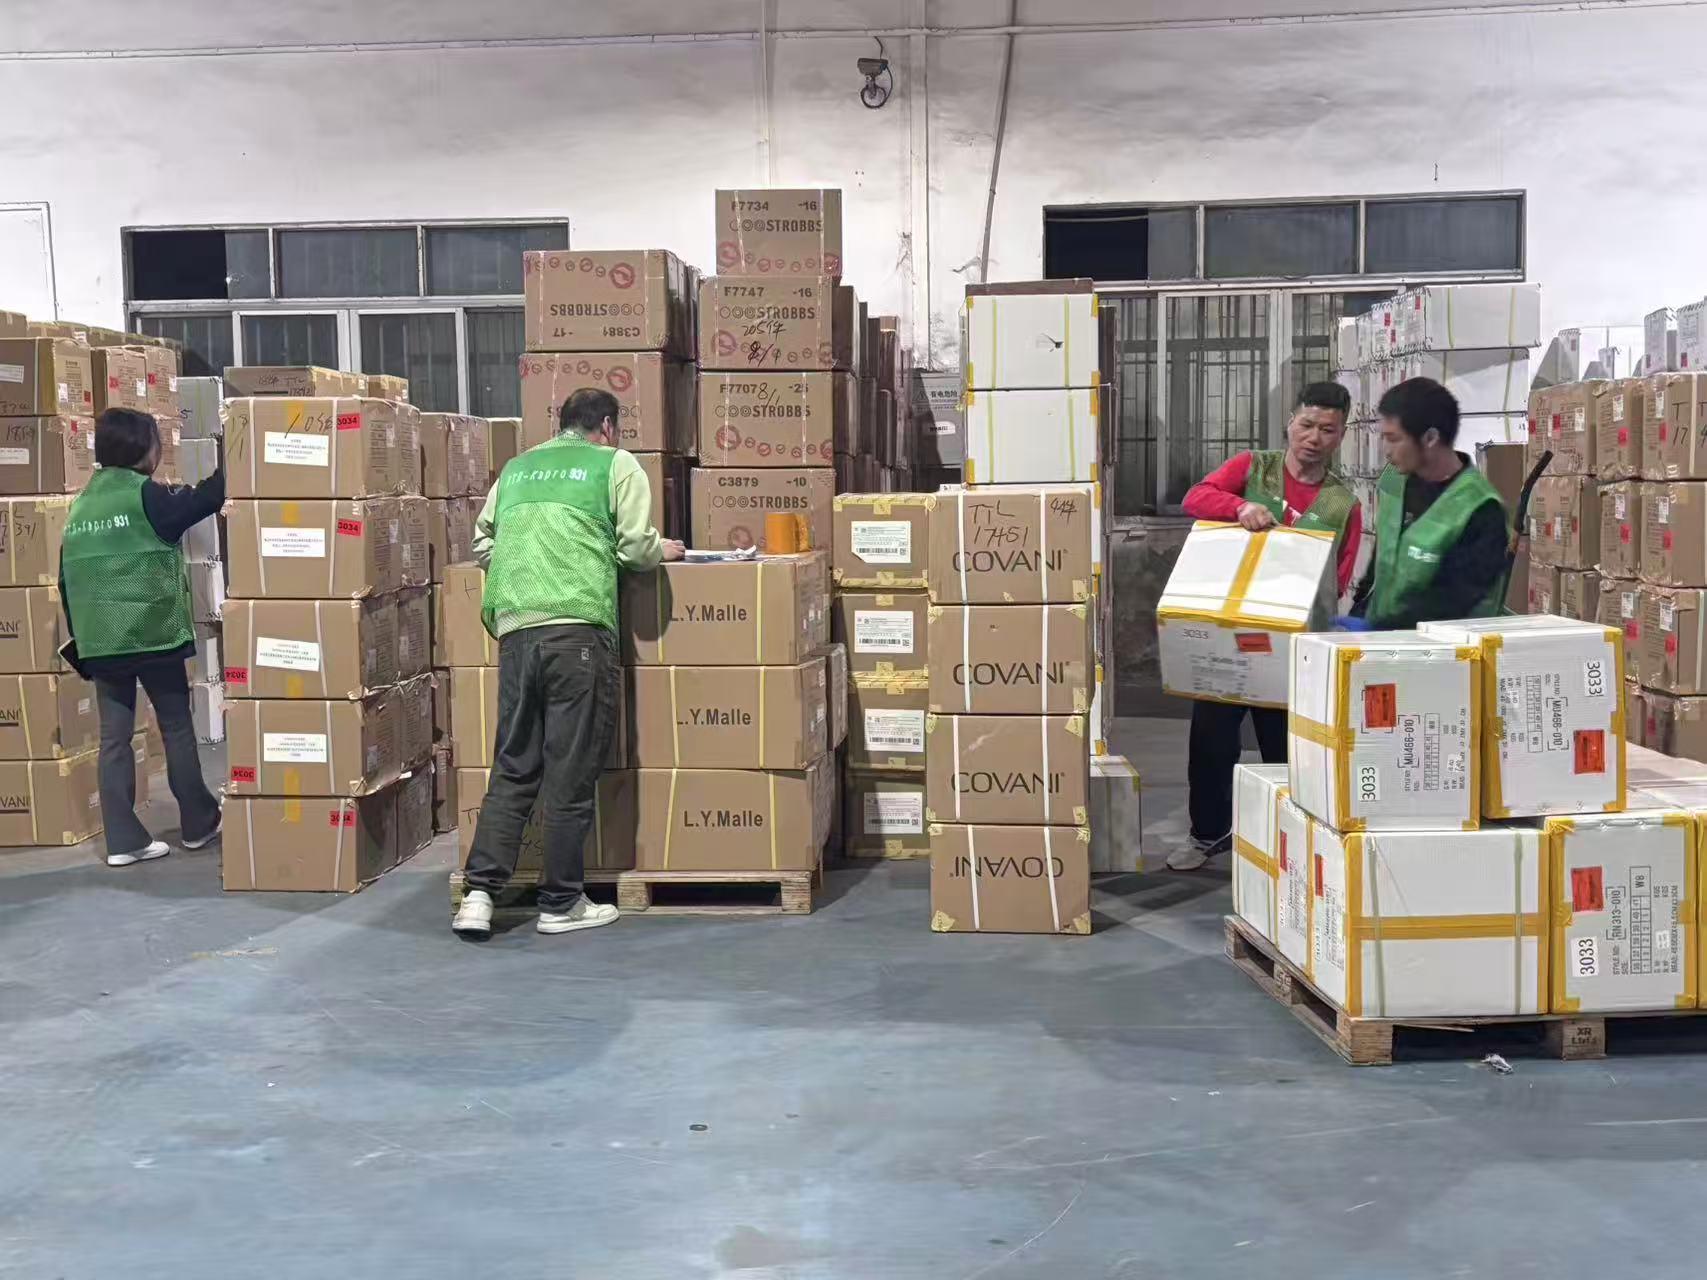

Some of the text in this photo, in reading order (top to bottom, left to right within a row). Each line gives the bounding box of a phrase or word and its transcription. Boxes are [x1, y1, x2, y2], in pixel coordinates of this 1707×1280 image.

[731, 202, 816, 211] F7734 -16
[766, 220, 823, 232] STROBBS
[724, 287, 812, 297] F7747 -16
[550, 304, 607, 316] STROBBS
[758, 306, 815, 319] STROBBS
[554, 327, 640, 337] C3881 -17
[720, 384, 757, 394] F7707
[753, 405, 810, 418] STROBBS
[718, 477, 807, 487] C3879 -10
[750, 497, 808, 508] STROBBS
[113, 514, 129, 528] 931
[953, 549, 1062, 572] COVANI
[953, 662, 1065, 685] COVANI
[1587, 662, 1602, 695] 3033
[1551, 700, 1563, 747] MU466-010
[1404, 719, 1415, 766] MU466-010
[951, 772, 1060, 794] COVANI
[1361, 766, 1376, 801] 3033
[684, 810, 763, 827] L.Y.Malle
[955, 856, 1064, 878] COVANI
[1635, 875, 1645, 889] W8
[1611, 890, 1622, 938] RN313-010
[1579, 939, 1595, 974] 3033
